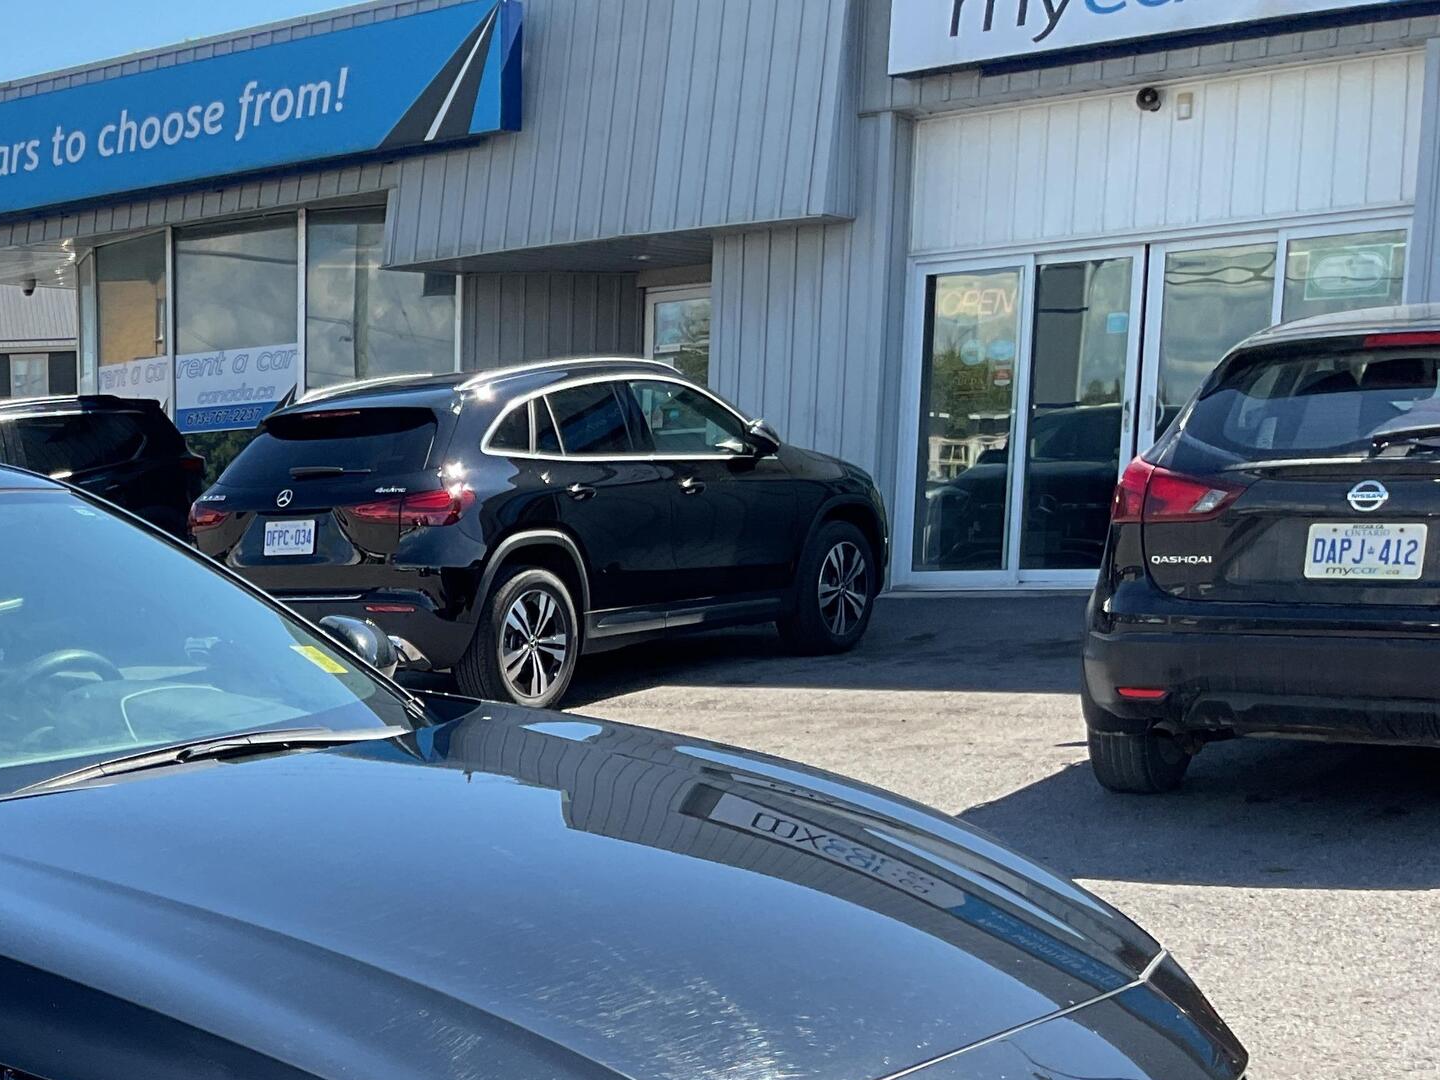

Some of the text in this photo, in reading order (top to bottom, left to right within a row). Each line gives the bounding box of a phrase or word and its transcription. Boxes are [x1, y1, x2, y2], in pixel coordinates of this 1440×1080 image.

[51, 125, 87, 167] to
[97, 109, 226, 157] choose
[234, 67, 349, 142] from!
[942, 287, 1017, 316] OPEN
[176, 348, 298, 379] rent a car
[1151, 555, 1213, 565] QASHQAI
